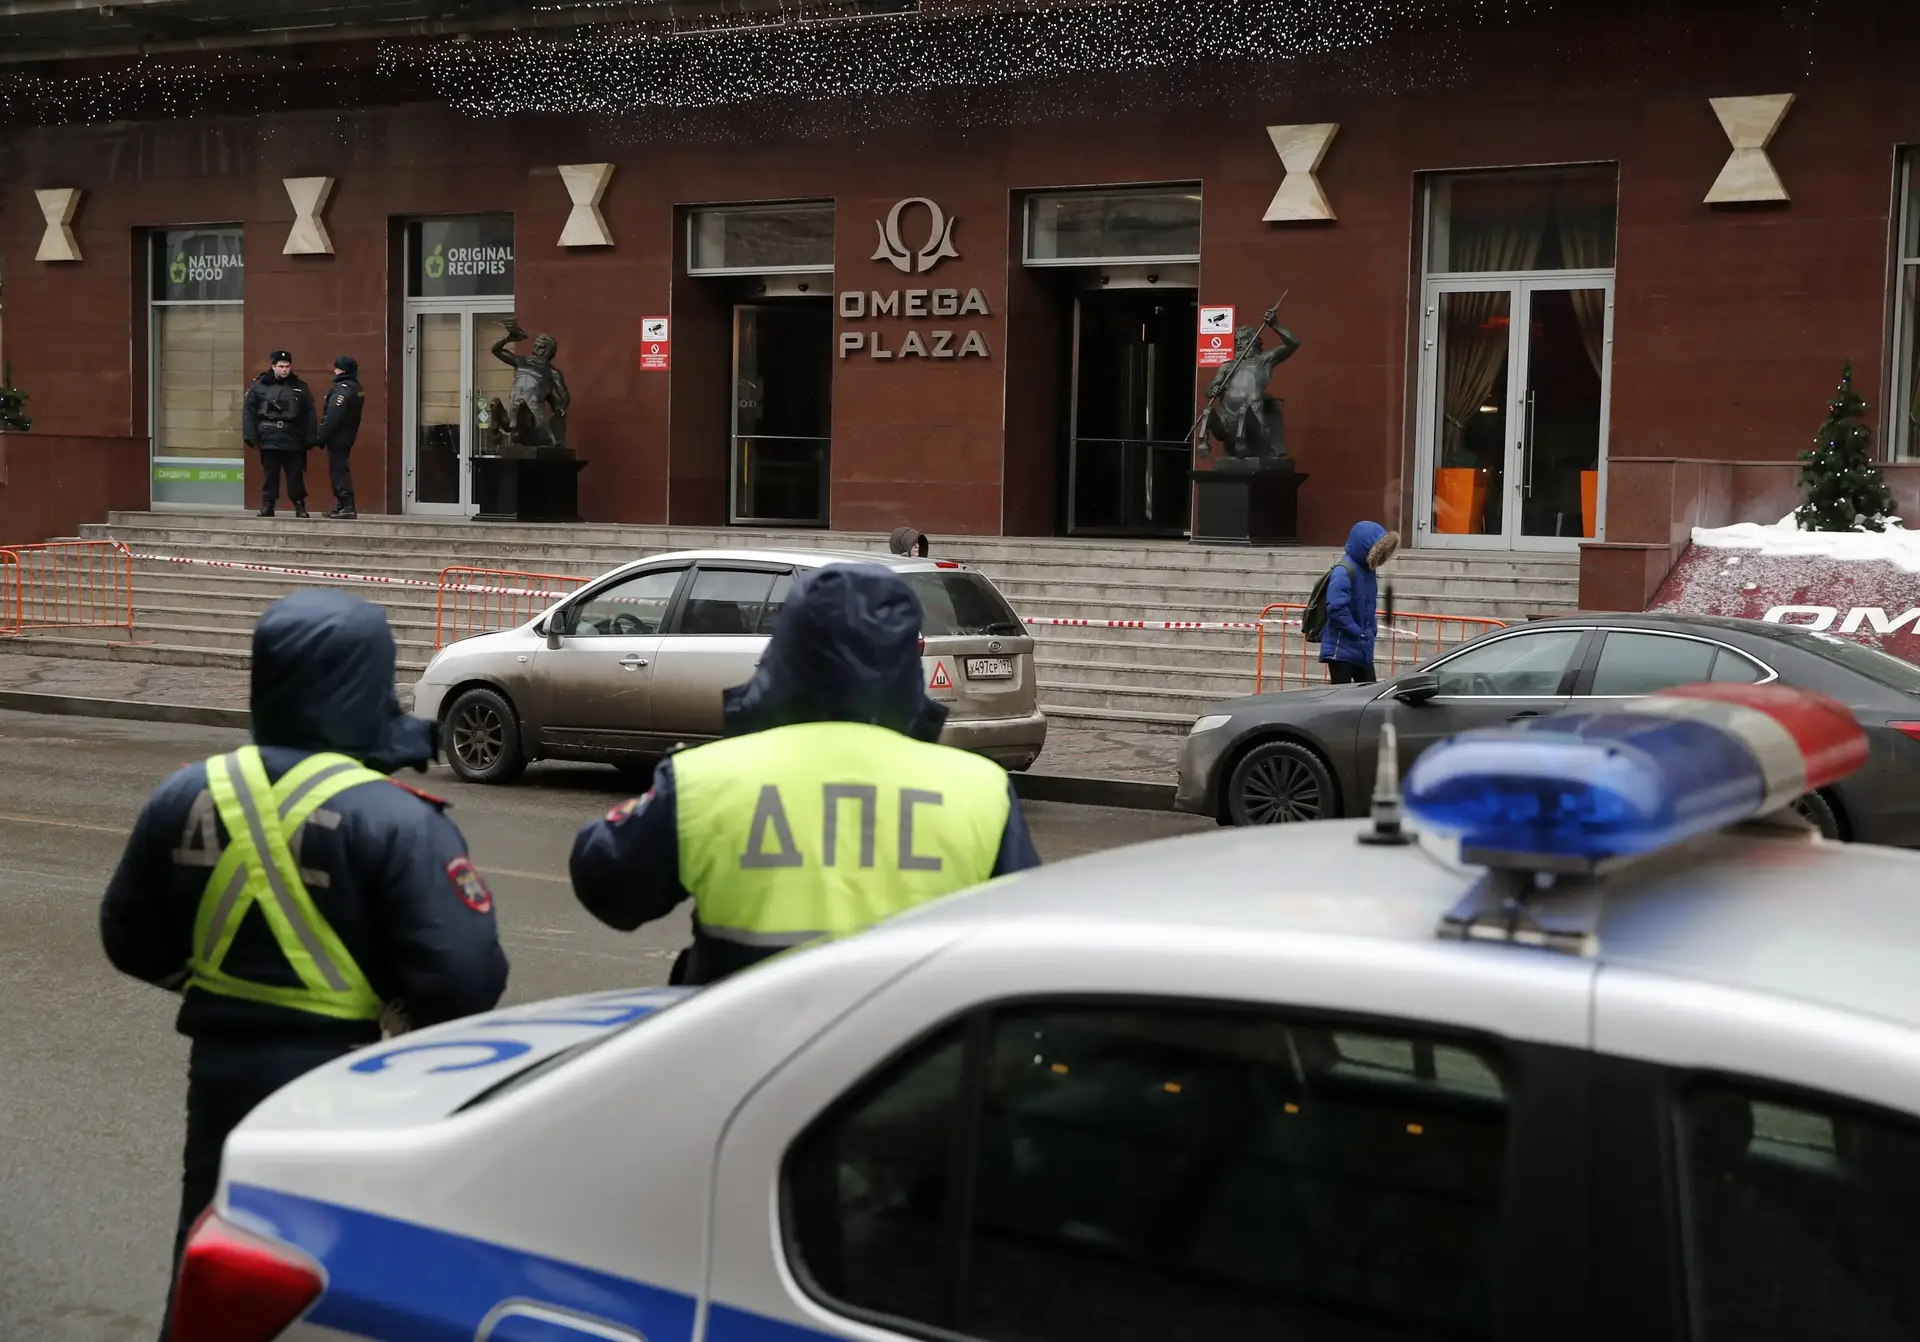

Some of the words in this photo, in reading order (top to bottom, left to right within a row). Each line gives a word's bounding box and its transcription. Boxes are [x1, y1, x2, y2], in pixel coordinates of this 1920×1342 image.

[189, 254, 244, 268] NATURAL
[448, 246, 514, 261] ORIGINAL
[189, 268, 223, 281] FOOD
[448, 260, 505, 275] RECIPIES
[839, 288, 989, 318] OMEGA
[839, 330, 989, 358] PLAZA
[936, 676, 945, 684] Ш
[739, 782, 943, 872] ДПС
